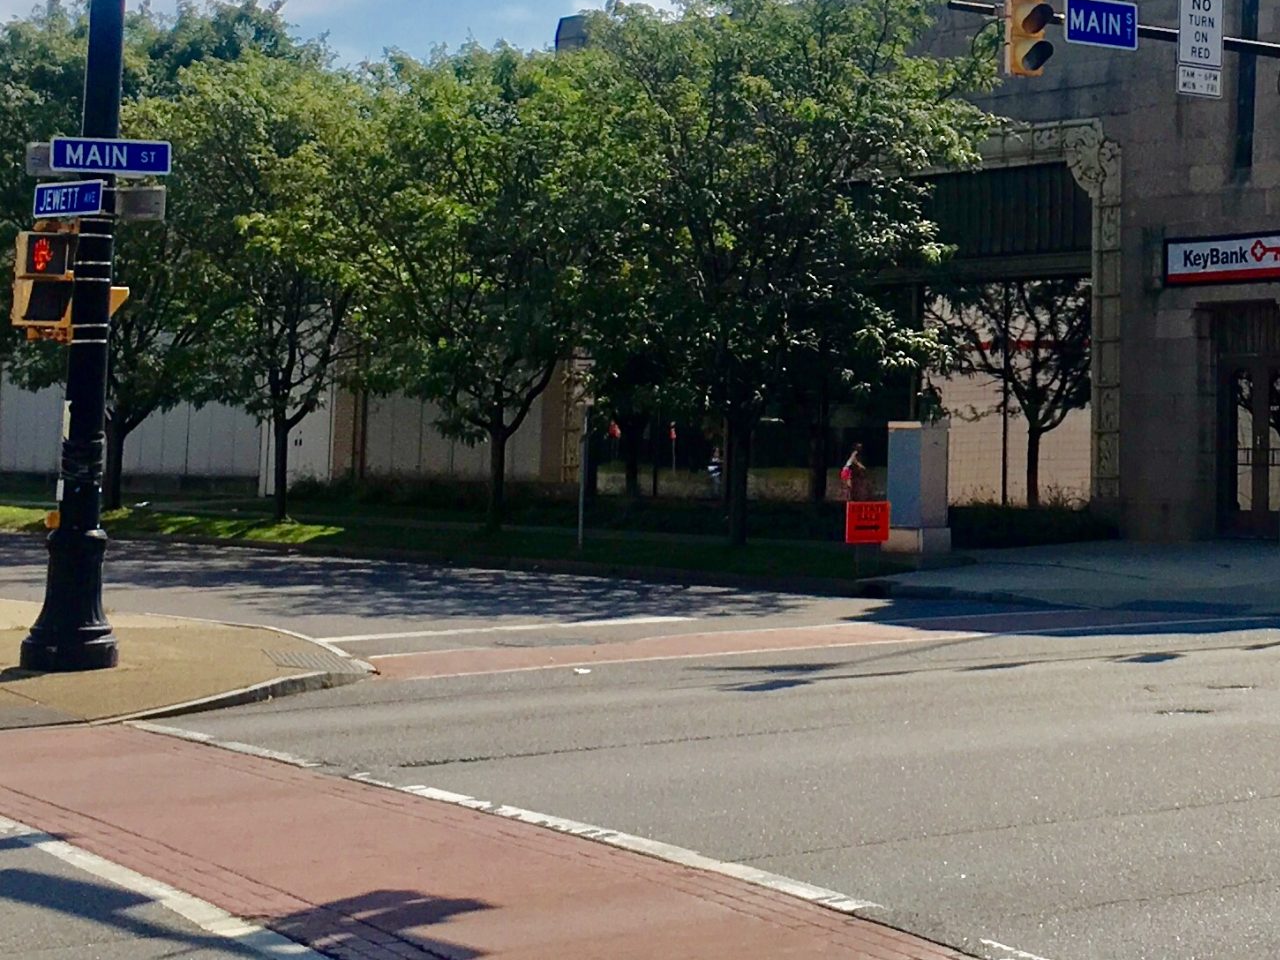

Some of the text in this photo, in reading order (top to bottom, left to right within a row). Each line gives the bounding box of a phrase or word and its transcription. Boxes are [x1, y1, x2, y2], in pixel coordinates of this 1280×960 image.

[1070, 7, 1120, 36] MAIN
[1189, 14, 1215, 29] TURN
[1194, 31, 1208, 43] ON
[1191, 47, 1210, 59] RED
[65, 143, 156, 167] MAIN ST
[40, 187, 96, 212] JEWETT AVE
[1183, 246, 1249, 270] KeyBank
